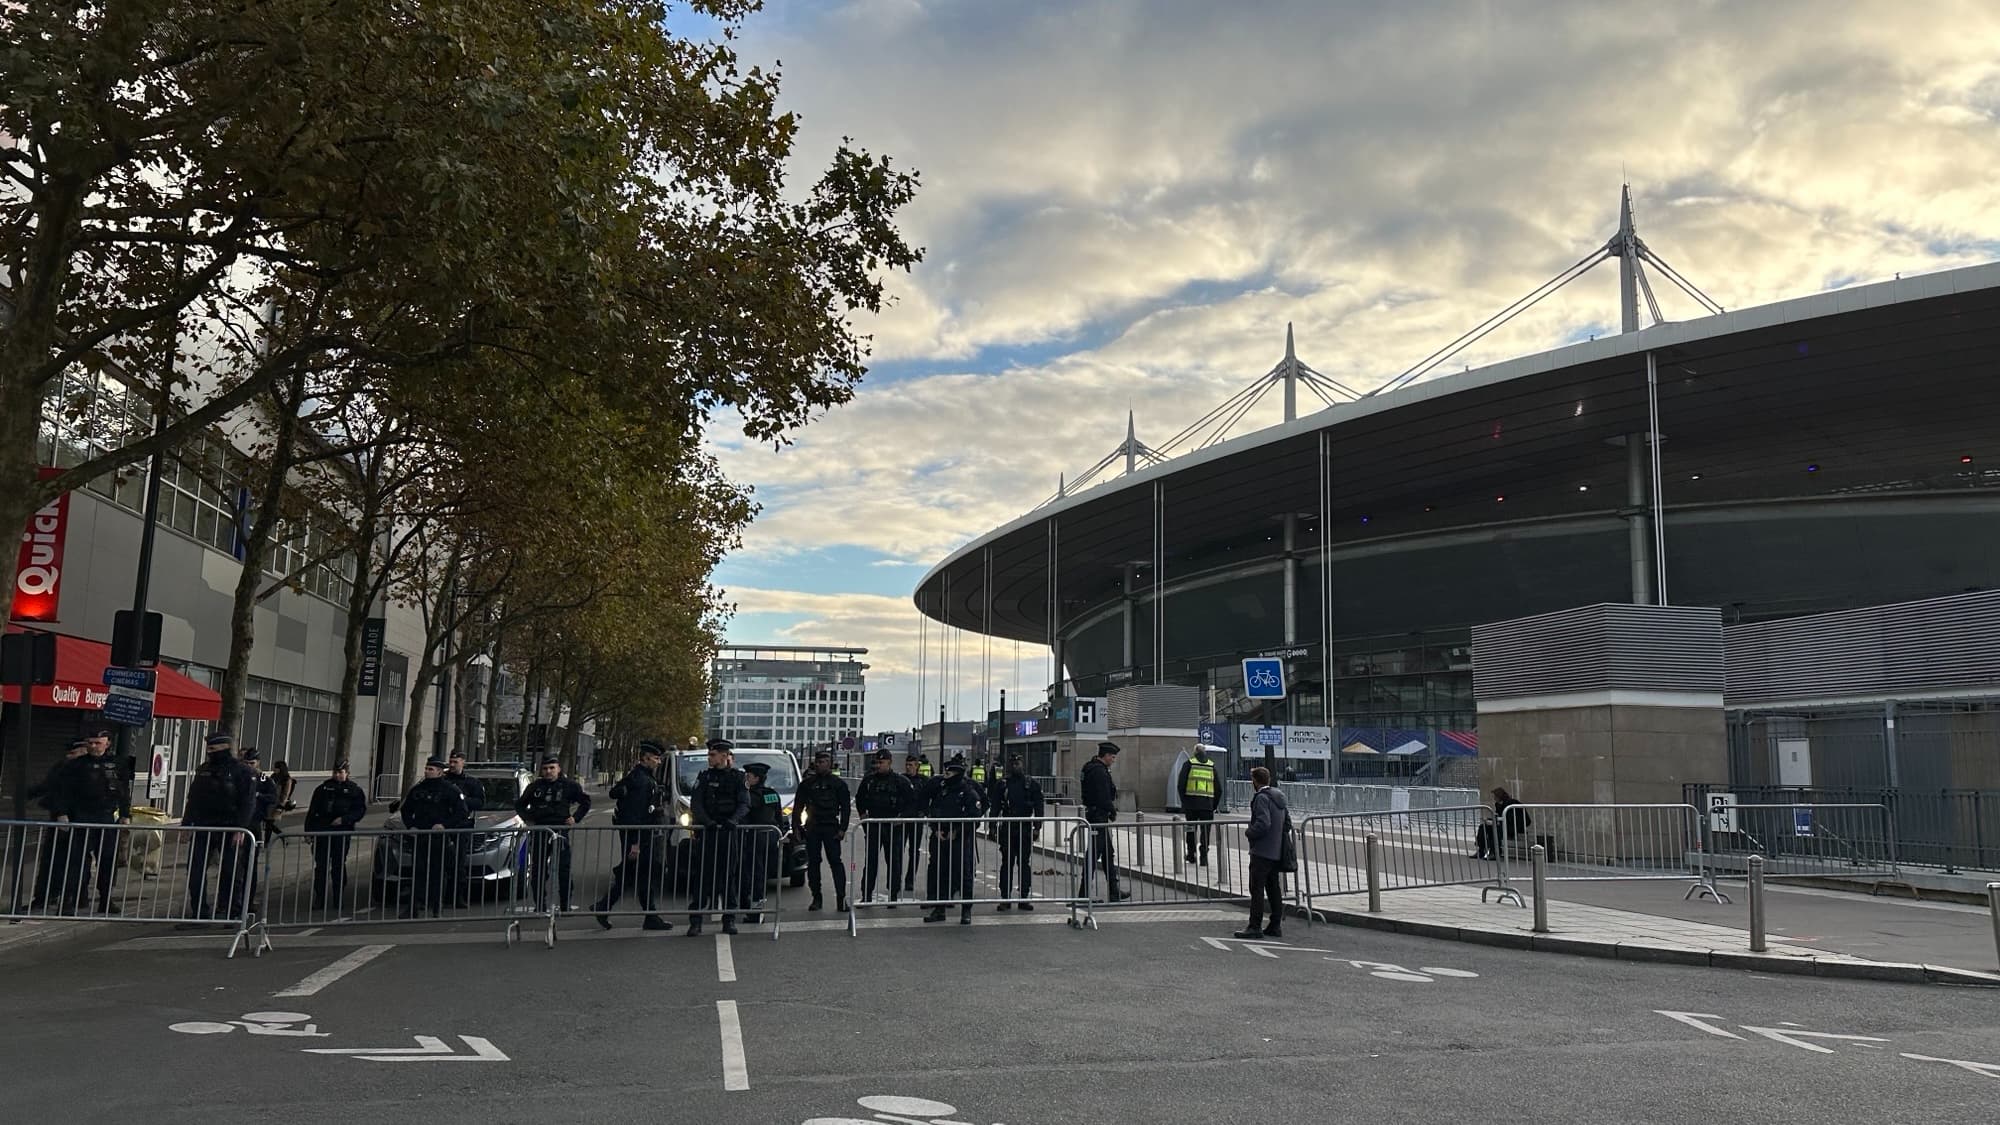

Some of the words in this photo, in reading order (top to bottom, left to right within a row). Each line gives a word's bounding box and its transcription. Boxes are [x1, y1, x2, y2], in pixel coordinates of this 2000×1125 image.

[53, 685, 80, 706] Quality
[85, 688, 109, 708] Burge
[1079, 706, 1093, 723] H
[885, 736, 894, 745] G
